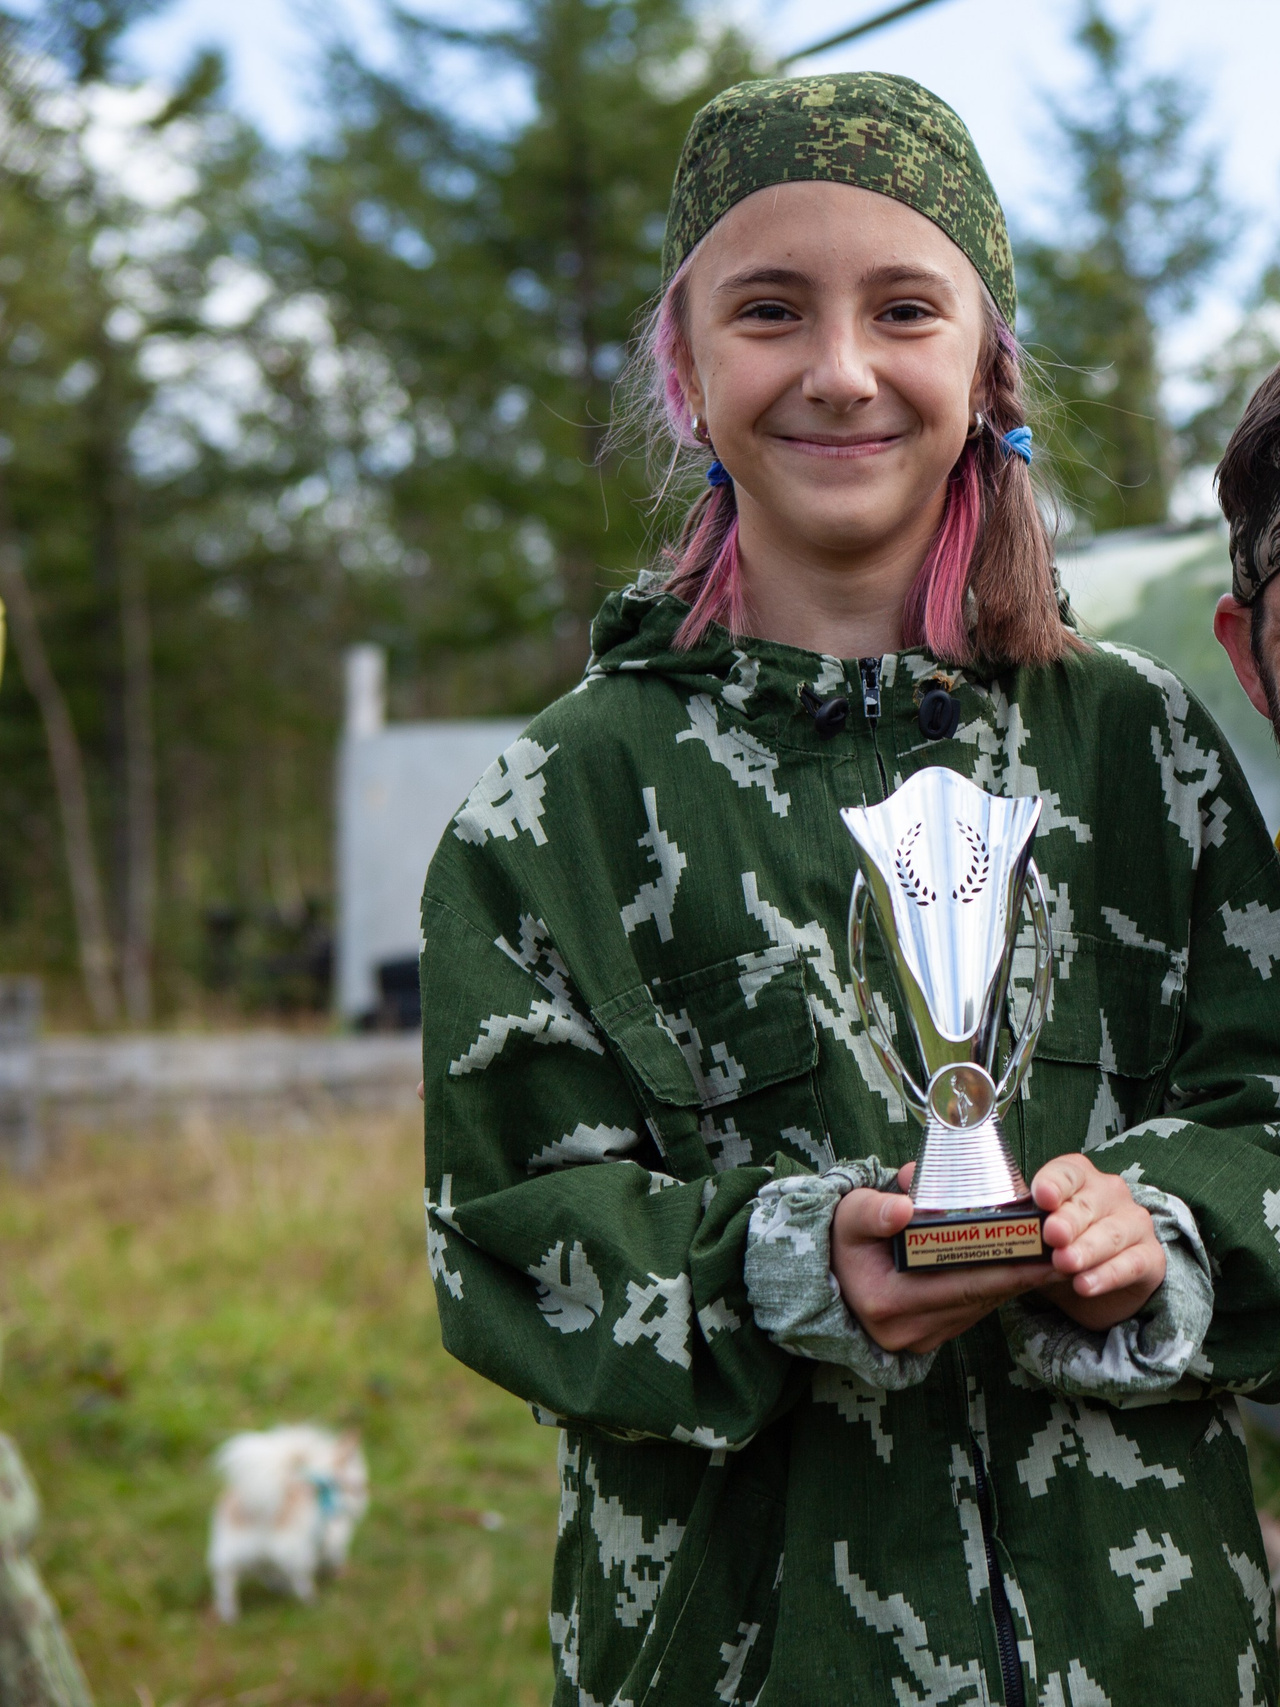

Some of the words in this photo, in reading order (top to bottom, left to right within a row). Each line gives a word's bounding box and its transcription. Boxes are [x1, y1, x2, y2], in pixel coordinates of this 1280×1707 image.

[907, 1227, 980, 1247] ЛУЧШИЙ
[985, 1223, 1039, 1240] ИГРОК
[936, 1251, 989, 1263] ДИВИЗИОН
[992, 1247, 1014, 1257] Ю-16
